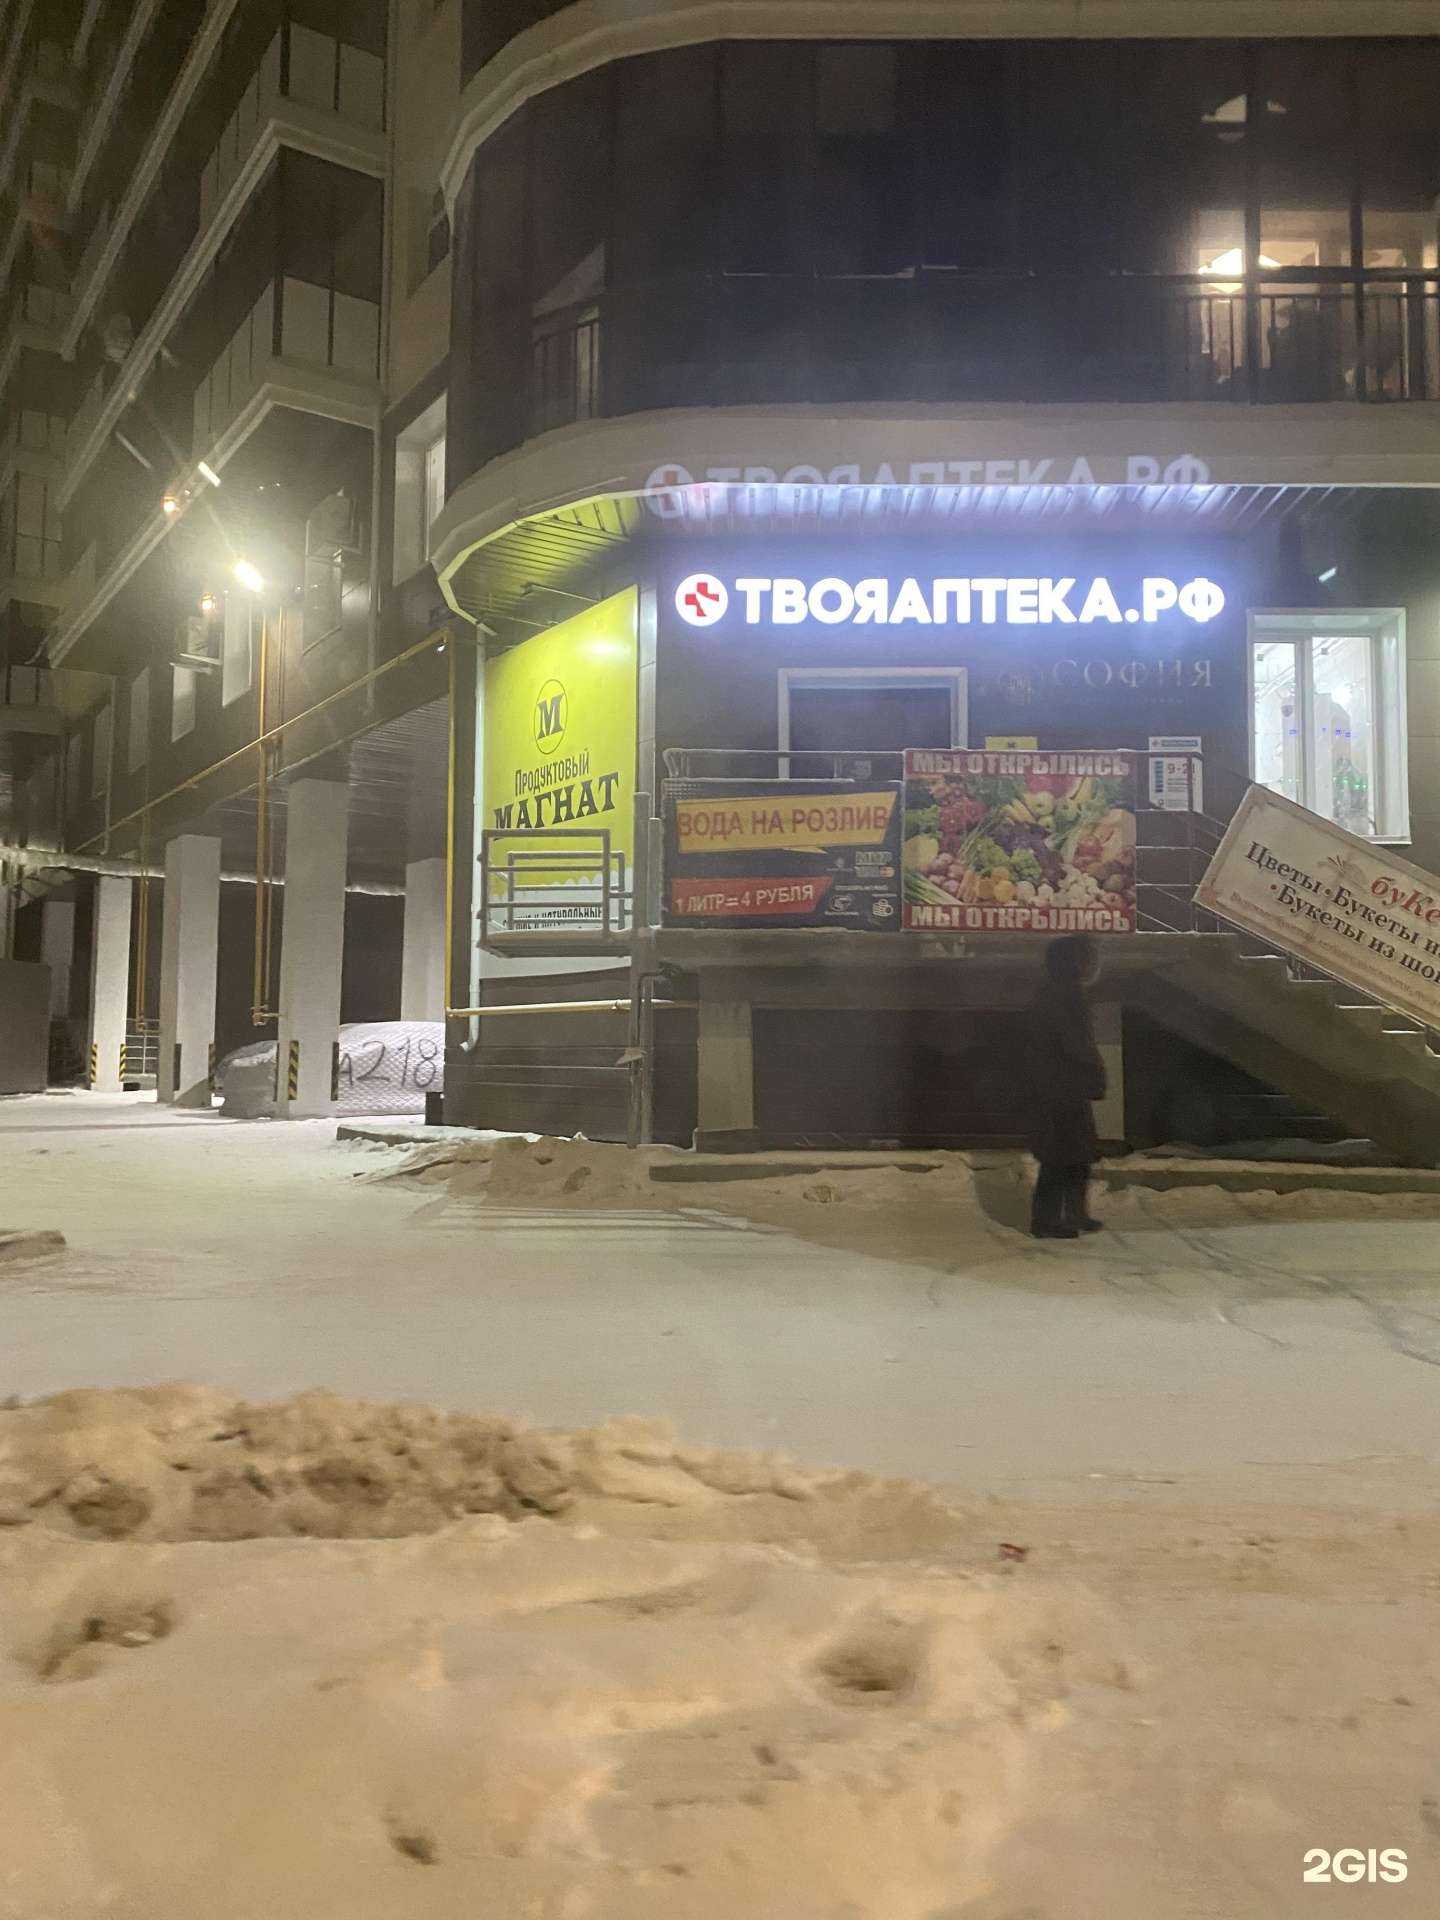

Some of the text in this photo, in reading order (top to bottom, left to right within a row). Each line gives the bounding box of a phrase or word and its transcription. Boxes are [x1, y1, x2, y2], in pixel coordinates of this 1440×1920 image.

[735, 577, 1225, 624] ТВОЯАПТЕКА.РФ
[1053, 659, 1212, 688] СОФИЯ
[910, 751, 1130, 776] МЫ ОТКРЫЛИСЬ
[493, 771, 619, 841] МАГНАТ
[678, 805, 888, 841] ВОДА НА РОЗЛИВ
[1245, 840, 1321, 895] Цветы
[756, 884, 814, 906] РУБЛЯ
[910, 905, 1130, 932] МЫ ОТКРЫЛИСЬ
[1368, 936, 1395, 960] из
